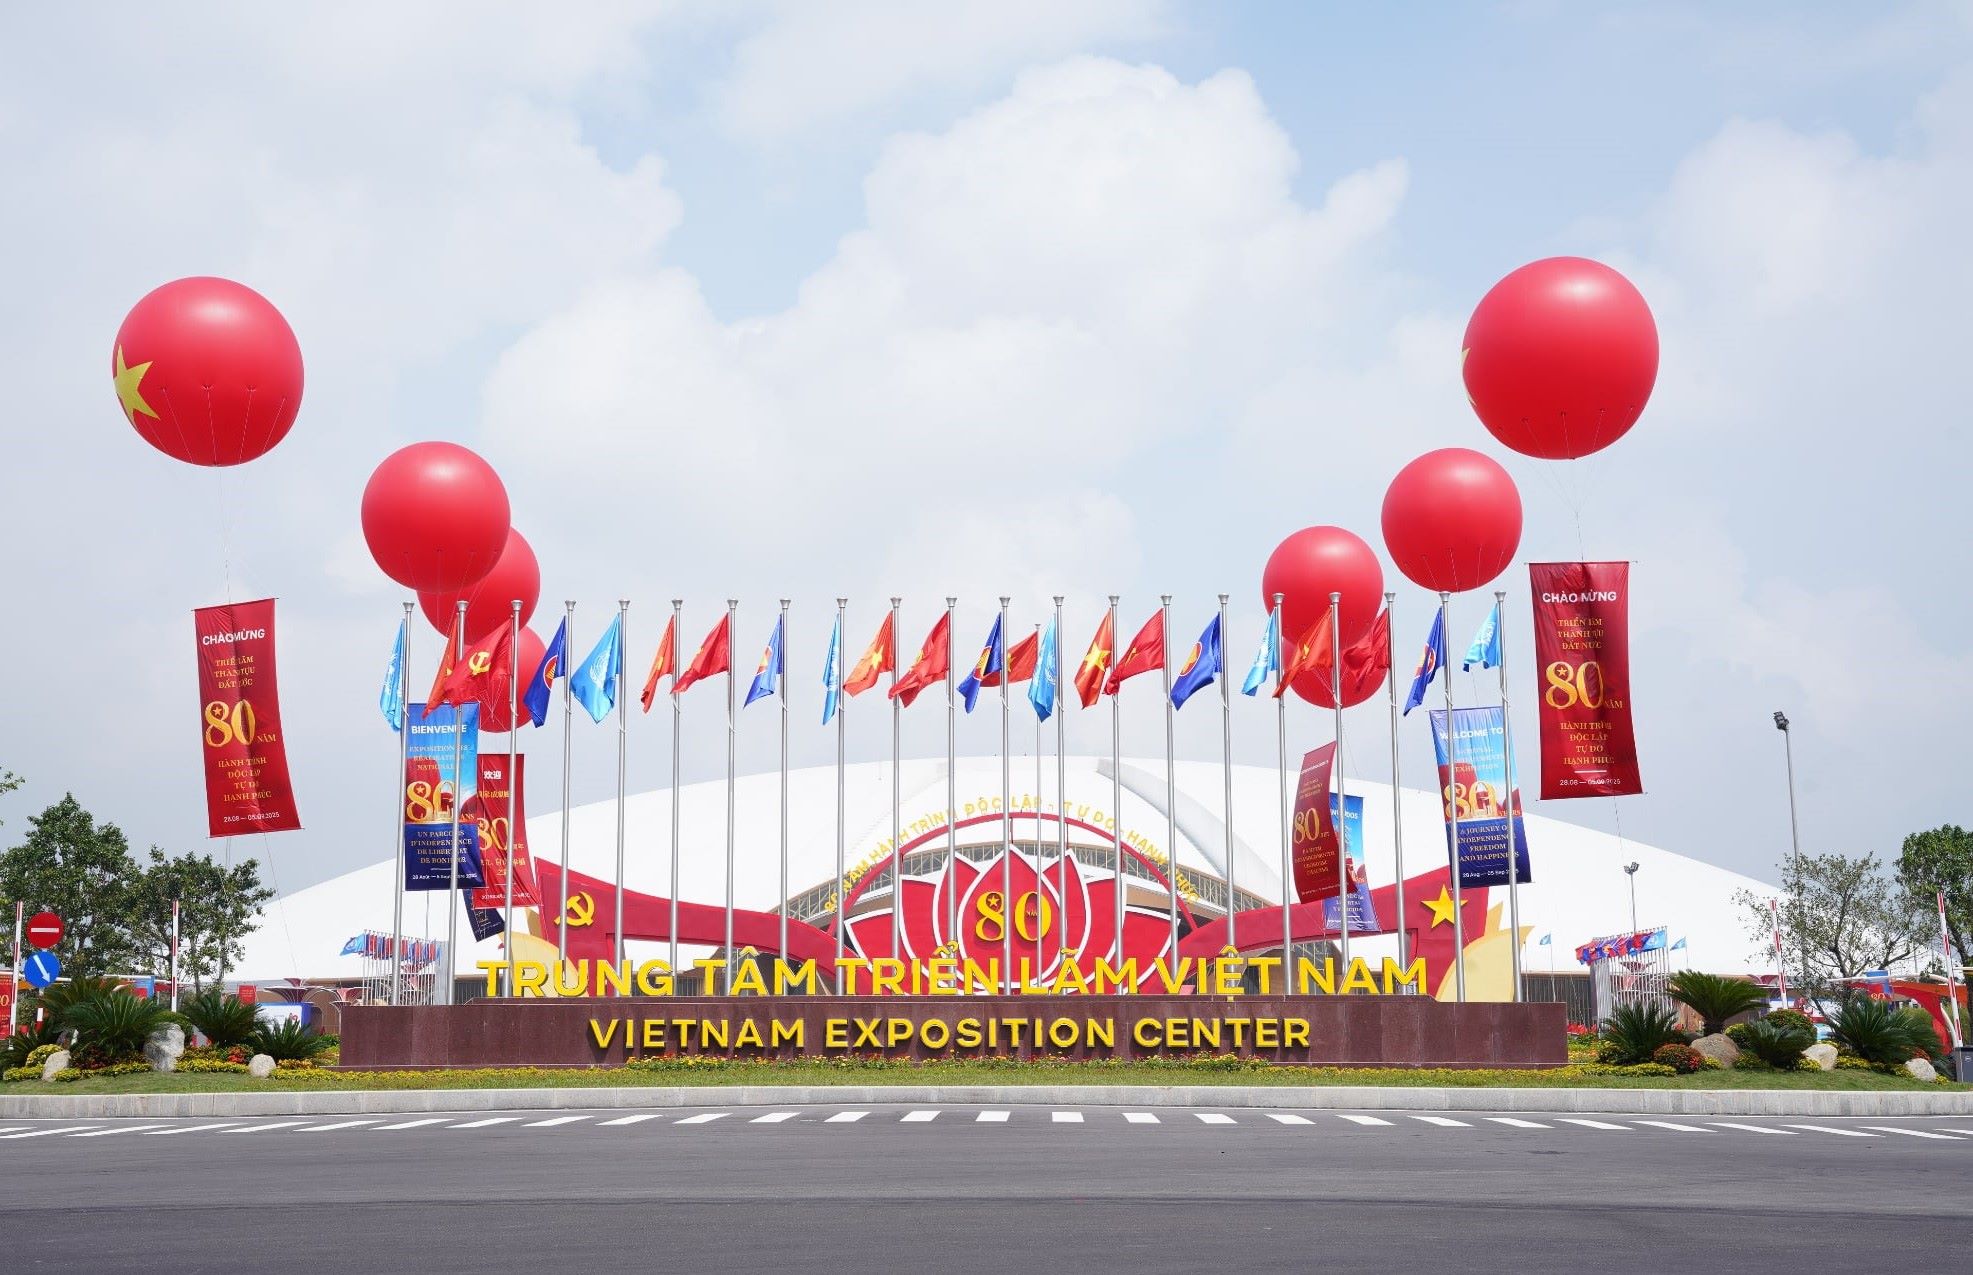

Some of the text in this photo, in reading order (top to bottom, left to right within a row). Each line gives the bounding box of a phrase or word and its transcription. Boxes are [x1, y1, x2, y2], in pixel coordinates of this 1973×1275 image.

[1542, 590, 1578, 603] CHÀO
[202, 631, 234, 646] CHÀO
[1545, 660, 1604, 710] 80
[205, 699, 256, 748] 80
[411, 724, 467, 735] BIENVENE
[1560, 721, 1587, 730] HÀNH
[1440, 727, 1504, 741] WLCOME TO
[483, 770, 502, 780] 欢迎
[406, 780, 454, 822] 80
[1443, 780, 1497, 819] 80
[1293, 806, 1320, 845] 80
[1466, 825, 1500, 834] JOURNEY
[429, 847, 457, 856] LIBERT
[1470, 843, 1507, 852] FREEDOM
[1459, 854, 1477, 862] AND
[976, 891, 1053, 941] 80
[476, 940, 1428, 1003] TRUNG TÂM TRIỂN LÃM VIỆT NAM
[589, 1017, 1312, 1049] VIETNAM EXPOSITION CENTER
